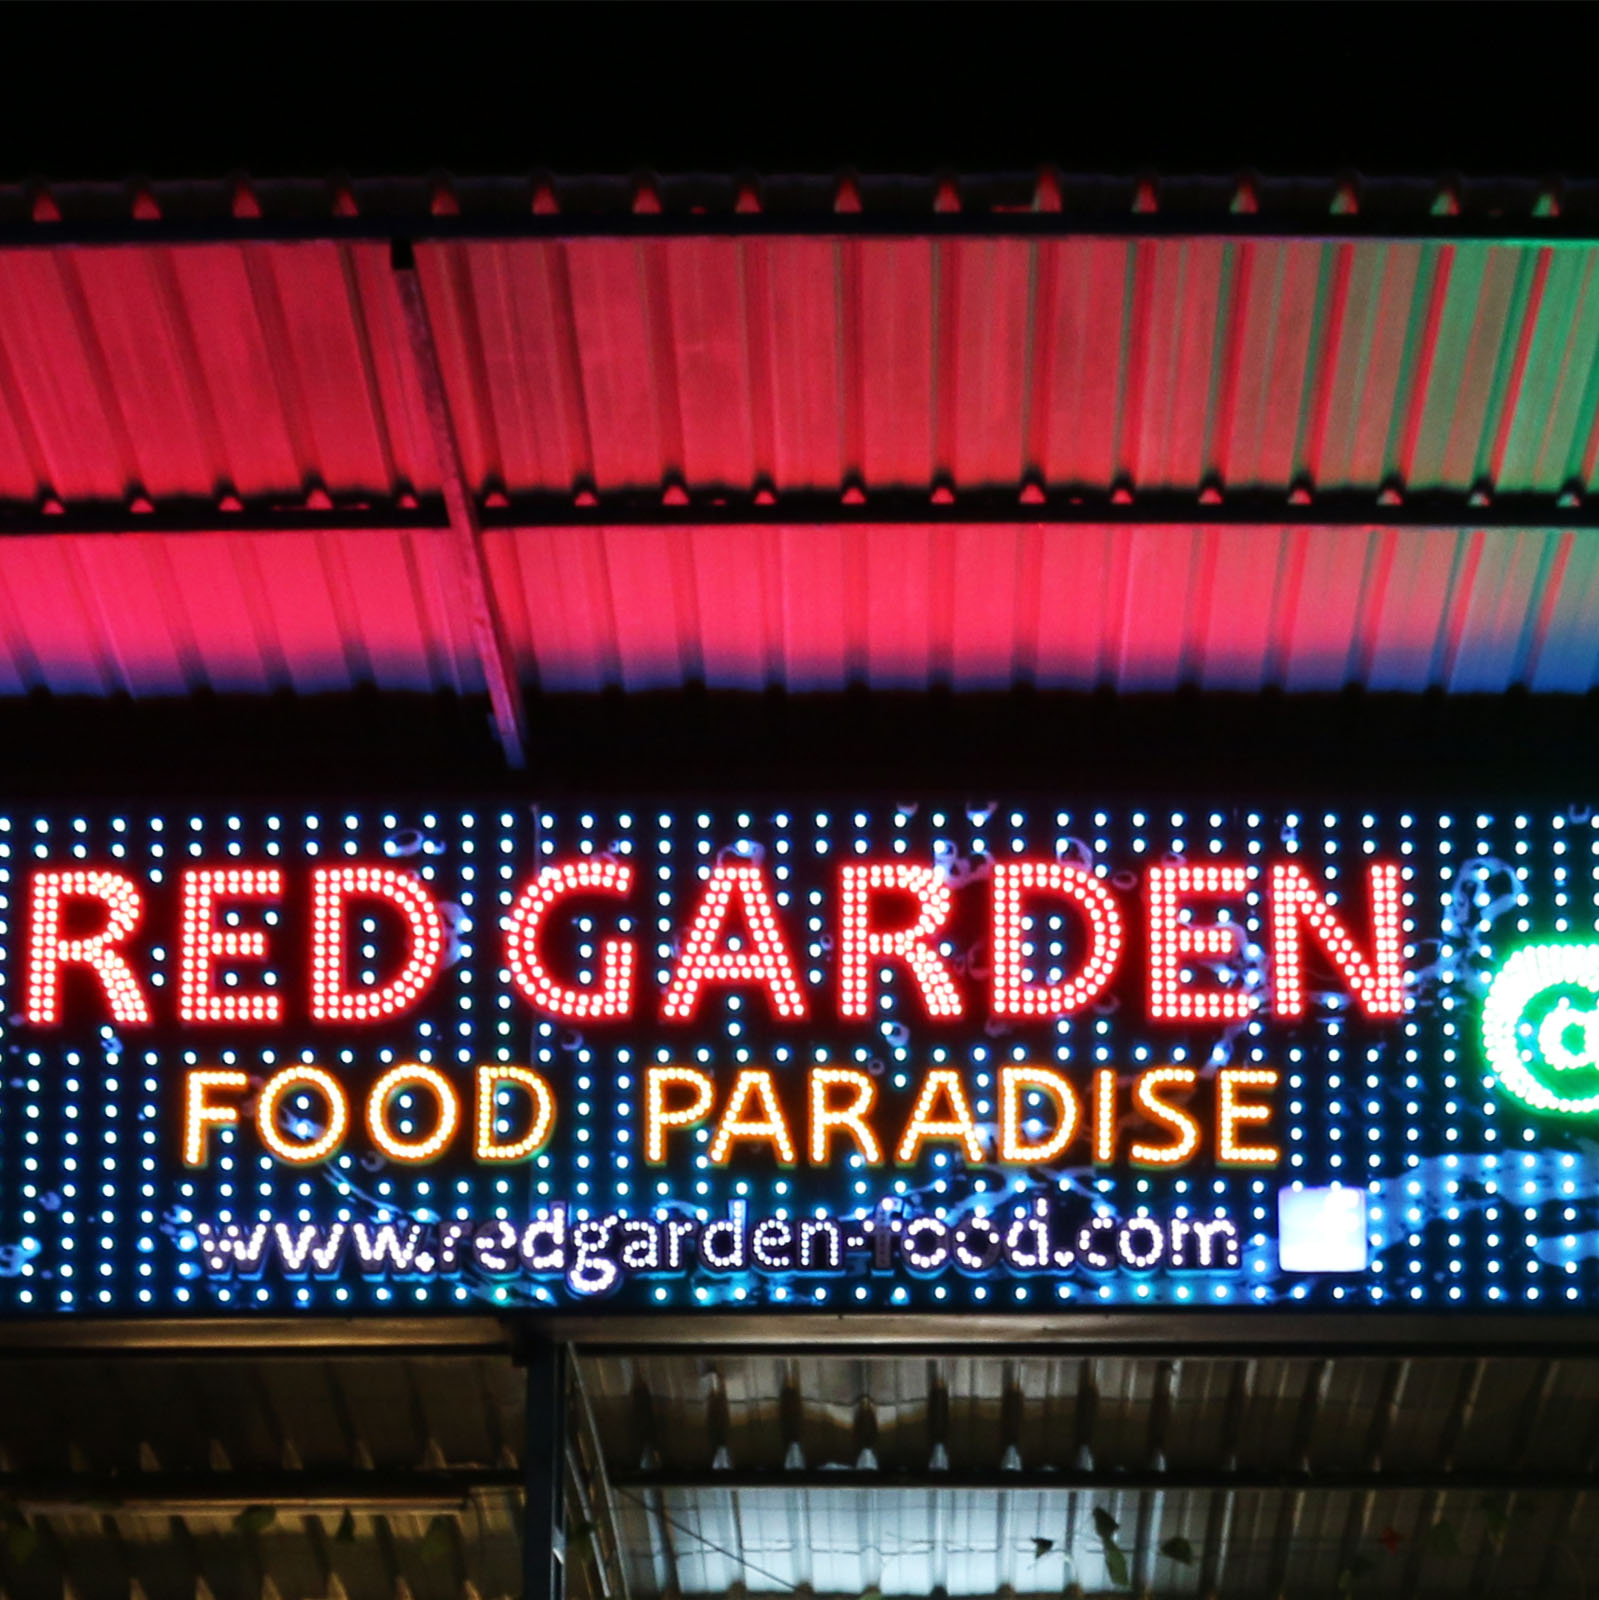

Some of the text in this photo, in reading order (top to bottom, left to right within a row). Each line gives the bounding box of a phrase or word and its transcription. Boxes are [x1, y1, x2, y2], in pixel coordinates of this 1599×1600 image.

[26, 860, 1408, 1024] RED GARDEN
[182, 1062, 1284, 1168] FOOD PARADISE
[198, 1197, 1244, 1296] www.redgarden-food.com
